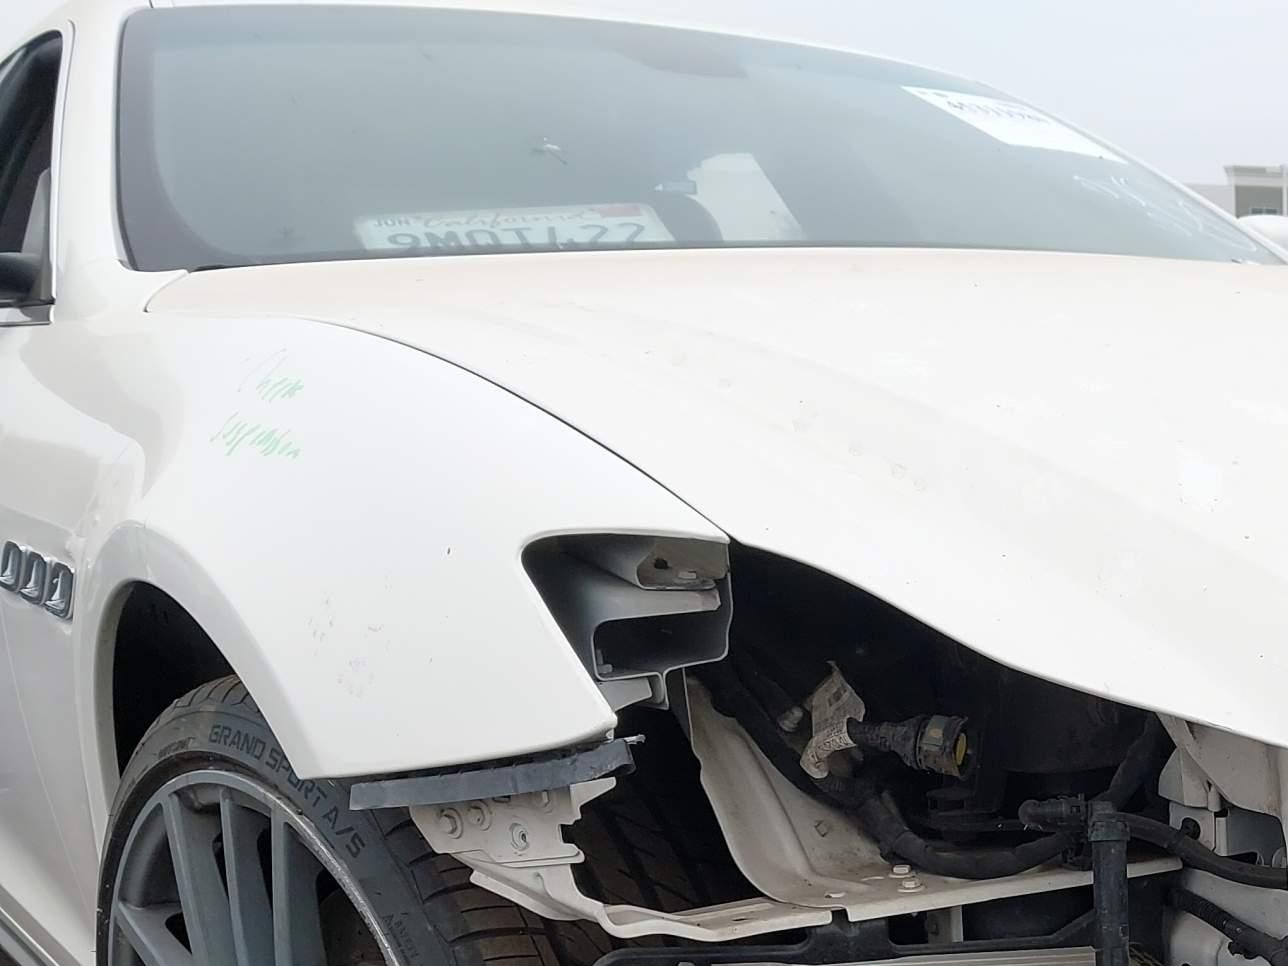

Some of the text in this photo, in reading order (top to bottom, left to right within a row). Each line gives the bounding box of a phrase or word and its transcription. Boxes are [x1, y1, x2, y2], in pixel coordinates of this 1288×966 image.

[208, 723, 266, 759] GRAND
[265, 748, 327, 807] SPORT
[321, 805, 366, 858] A/S
